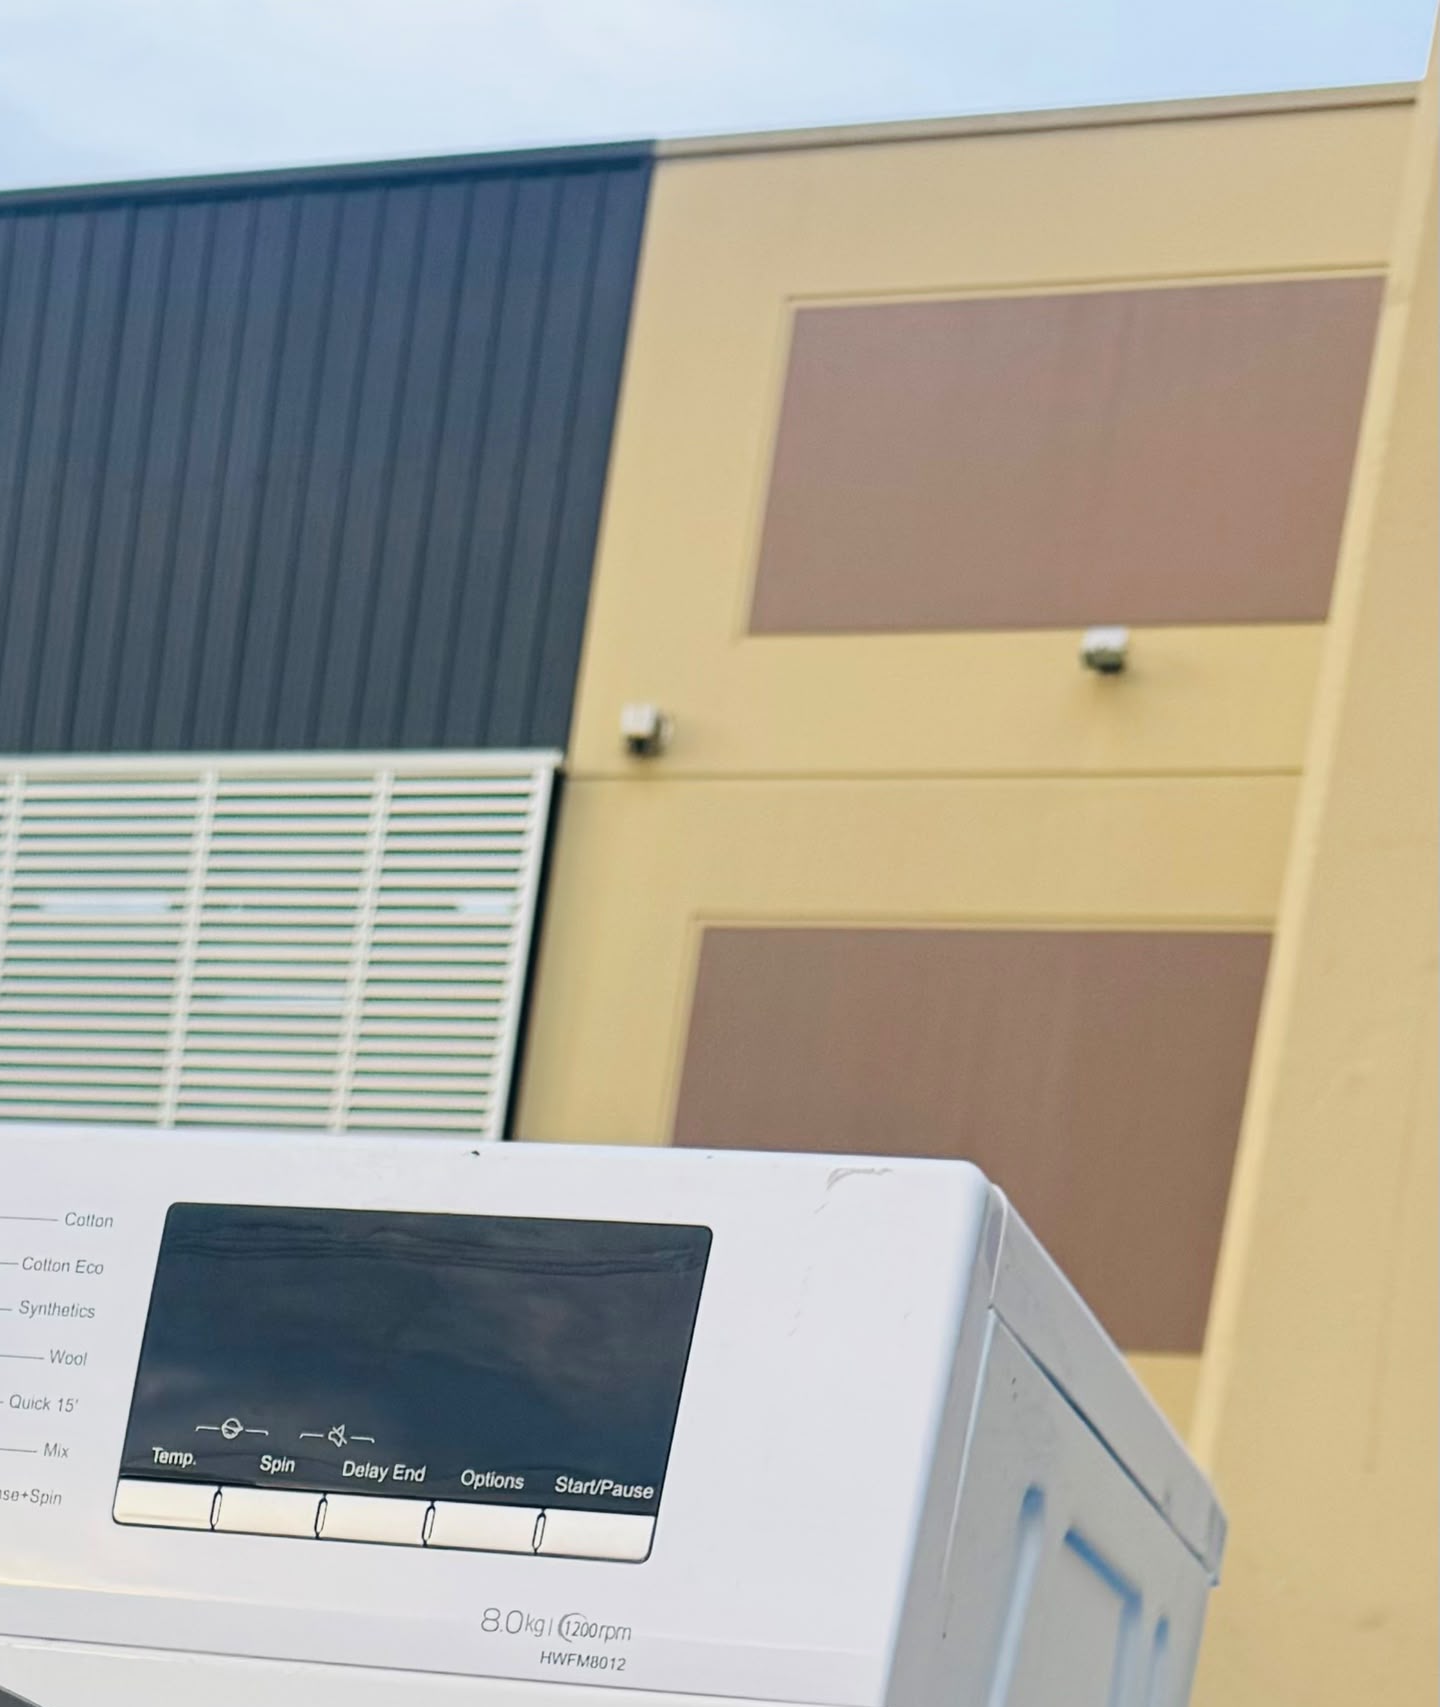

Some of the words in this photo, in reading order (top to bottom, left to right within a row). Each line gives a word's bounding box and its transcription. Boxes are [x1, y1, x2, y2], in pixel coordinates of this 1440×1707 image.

[65, 1212, 114, 1228] Cotton
[22, 1256, 71, 1273] Cotton
[75, 1259, 104, 1275] Eco
[19, 1300, 96, 1320] Synthetics
[49, 1349, 88, 1366] Wool
[9, 1394, 51, 1411] Quick
[58, 1397, 79, 1413] 15'
[43, 1442, 70, 1459] Mix
[152, 1447, 197, 1468] Temp.
[259, 1455, 296, 1473] Spin
[342, 1460, 389, 1483] Delay
[393, 1463, 427, 1482] End
[460, 1469, 525, 1490] Options
[555, 1475, 654, 1499] Start/Pause
[481, 1607, 545, 1637] 8.0kg
[540, 1651, 626, 1672] HWFM8012
